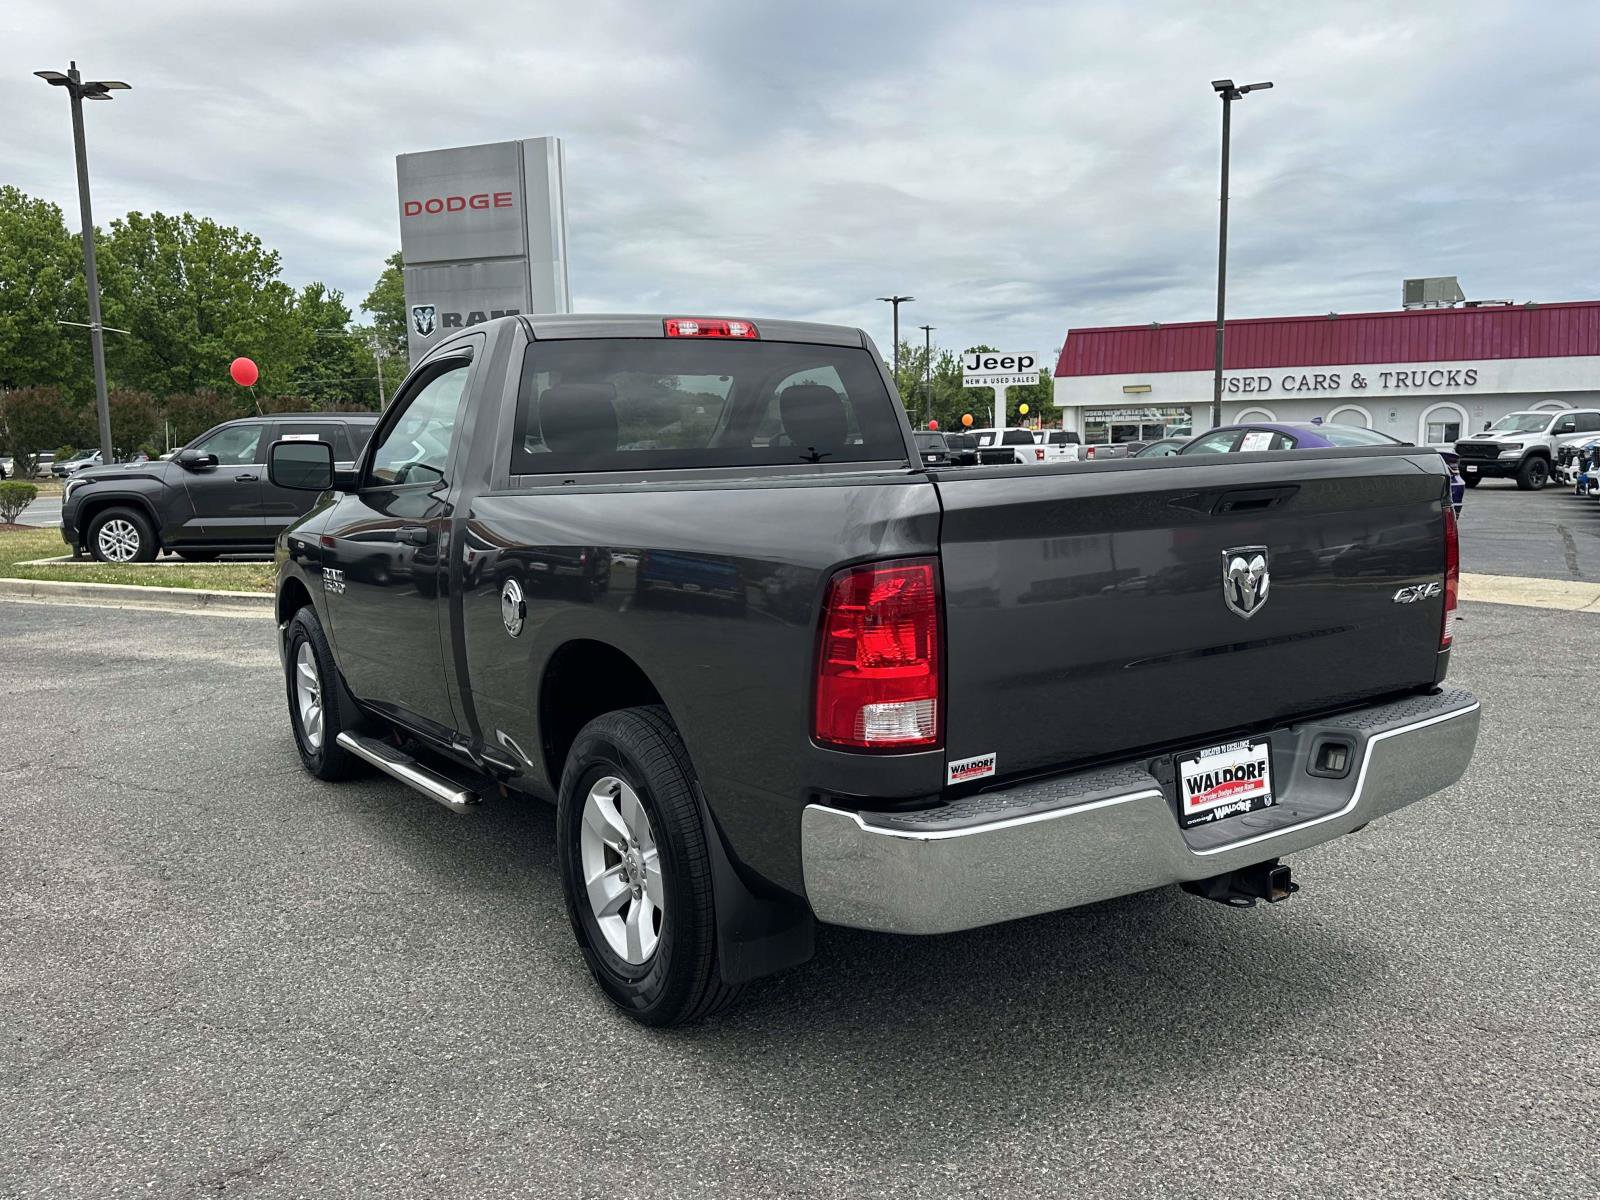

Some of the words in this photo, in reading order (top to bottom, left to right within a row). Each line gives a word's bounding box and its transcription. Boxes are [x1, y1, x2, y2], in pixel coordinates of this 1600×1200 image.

[404, 192, 512, 216] DODGE
[966, 354, 1034, 372] Jeep
[1281, 373, 1341, 392] CARS
[1351, 373, 1367, 389] &
[1379, 368, 1479, 389] TRUCKS
[951, 758, 994, 774] WALDORF
[1186, 760, 1266, 795] WALDORF
[1214, 800, 1252, 819] WALDORF
